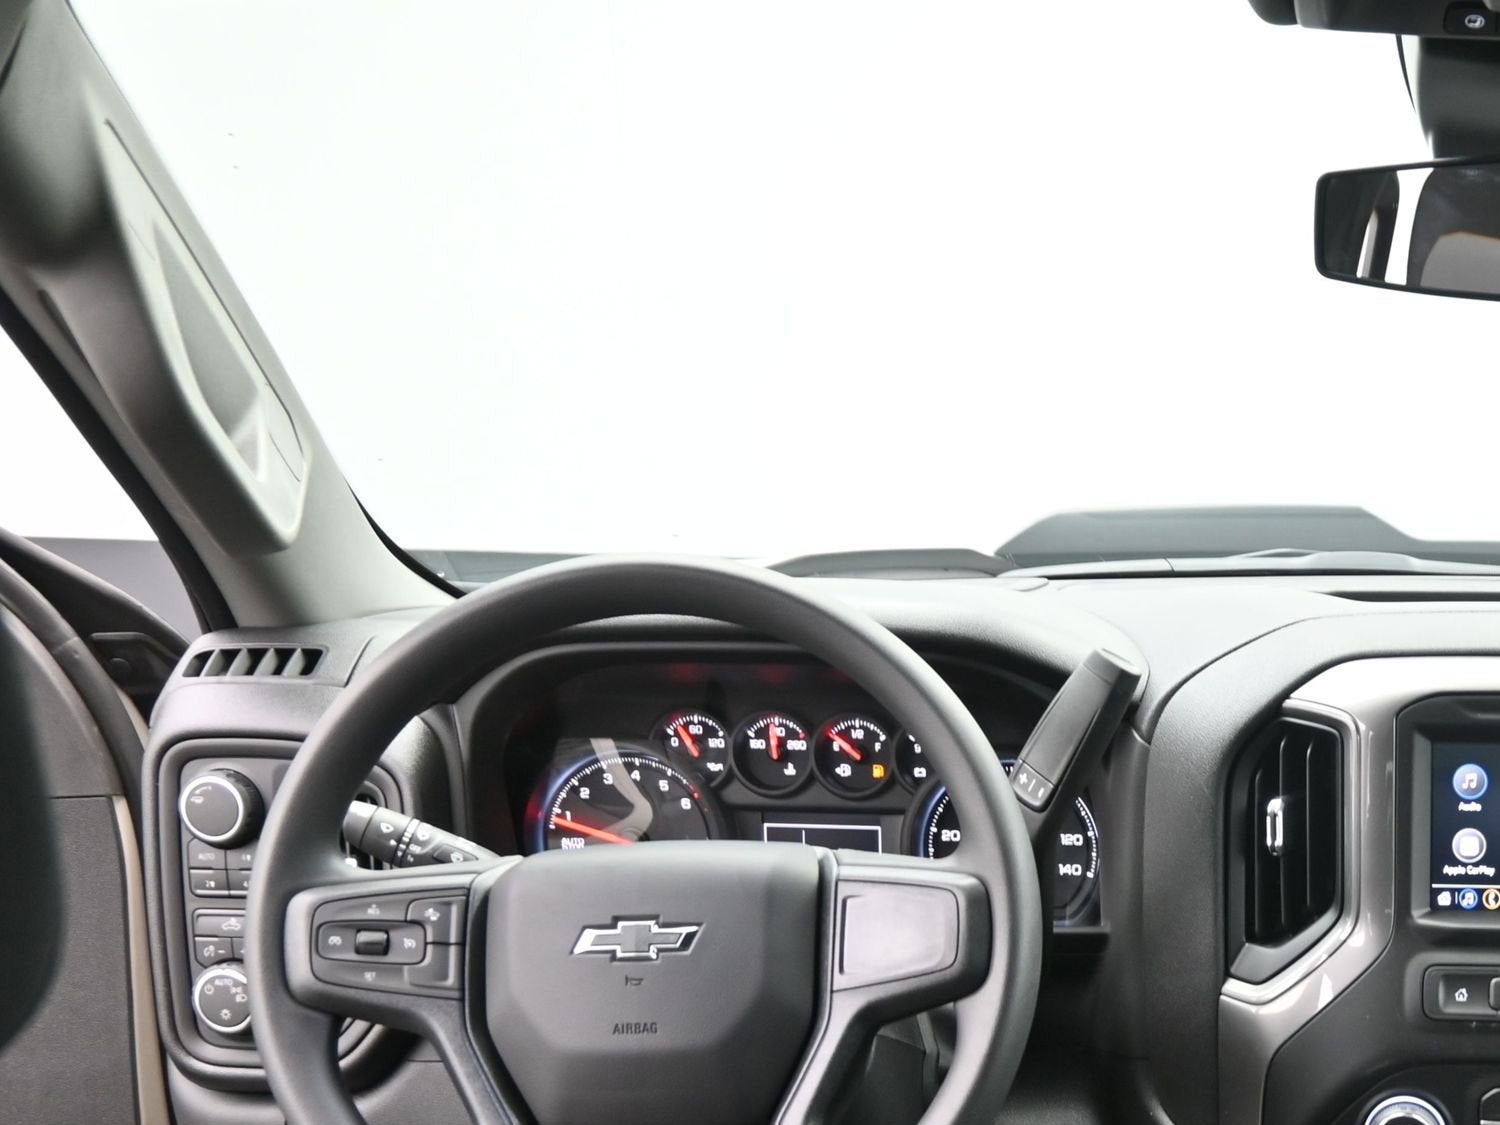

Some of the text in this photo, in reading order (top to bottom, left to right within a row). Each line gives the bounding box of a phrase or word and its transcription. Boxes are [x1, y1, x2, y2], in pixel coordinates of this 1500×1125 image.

[689, 725, 702, 734] 60
[671, 737, 679, 747] 0
[708, 738, 724, 748] 120
[750, 739, 766, 749] 160
[787, 740, 806, 750] 260
[875, 742, 881, 752] F
[603, 773, 613, 785] 3
[630, 770, 641, 781] 4
[659, 780, 669, 791] 5
[580, 787, 590, 799] 2
[681, 798, 691, 810] 6
[1458, 802, 1482, 812] Audio
[565, 811, 572, 822] 1
[941, 830, 961, 842] 20
[1060, 833, 1083, 846] 120
[1058, 864, 1082, 876] 140
[1442, 864, 1495, 877] Apple CarPlay
[214, 978, 233, 986] AUTO
[612, 1022, 658, 1035] AIRBAG
